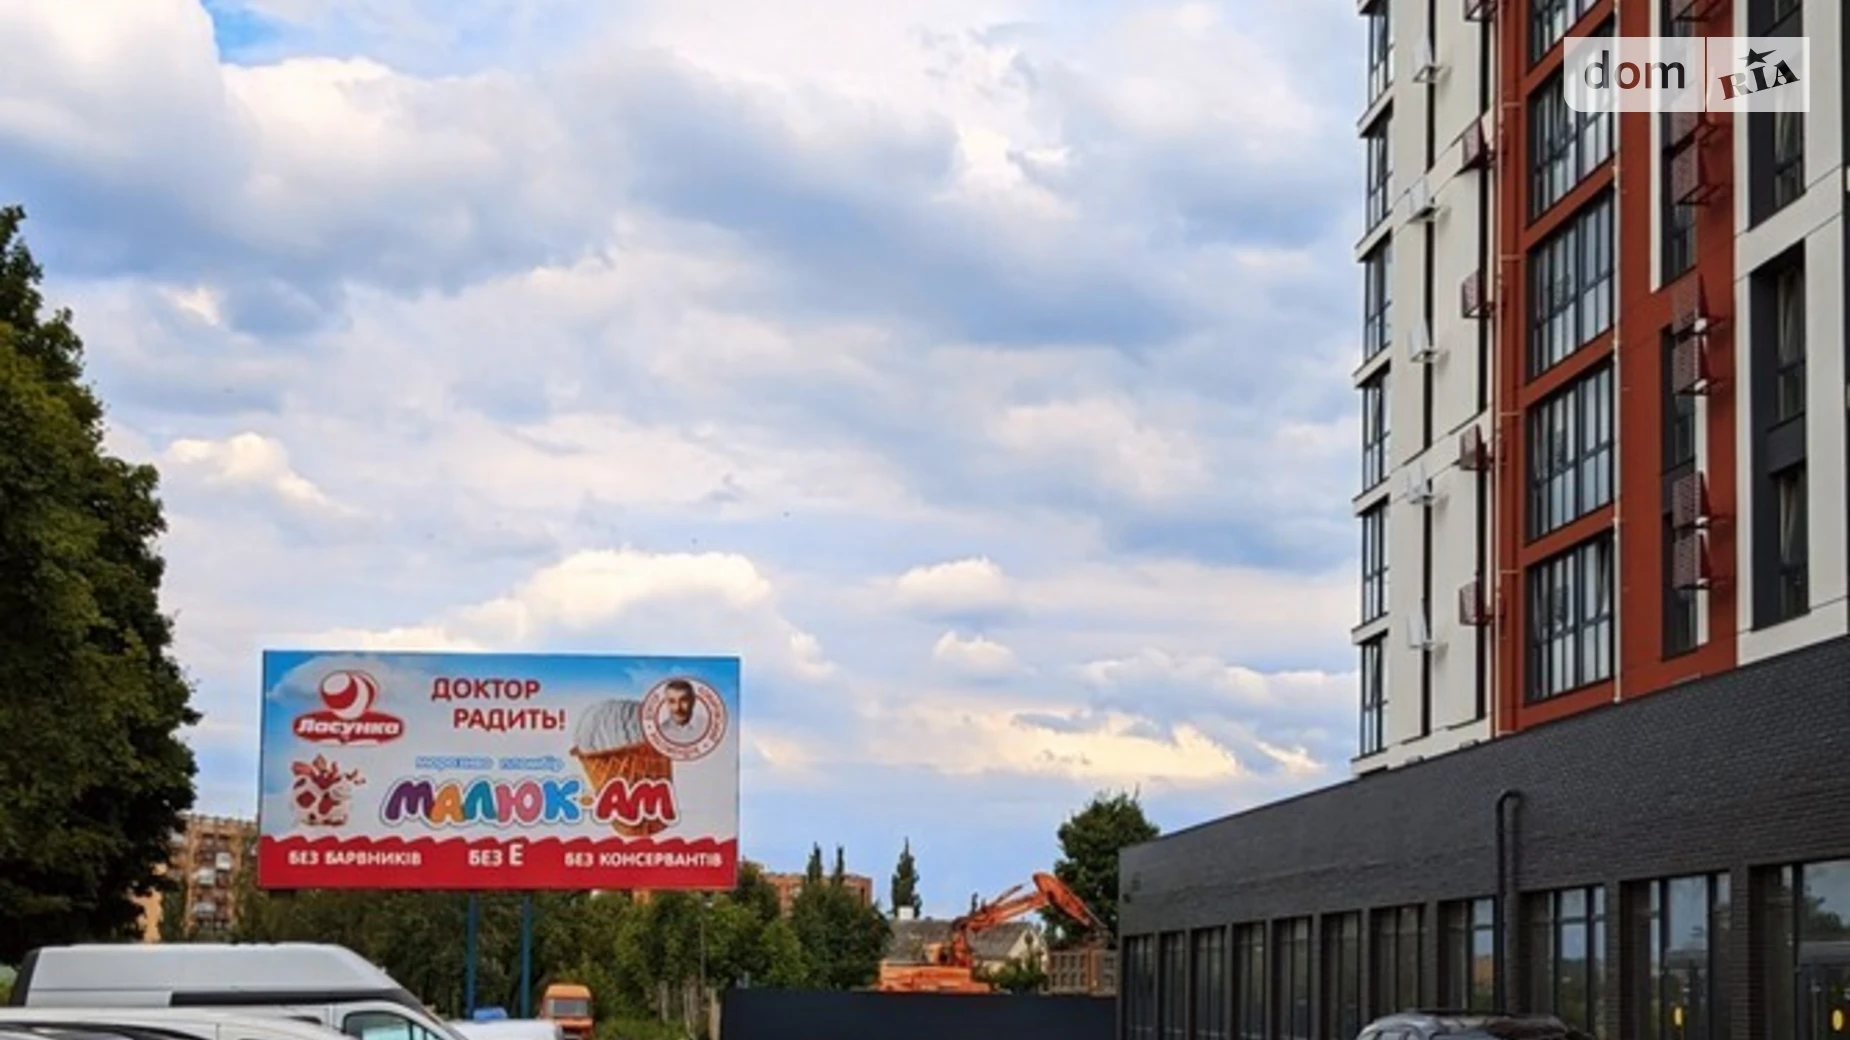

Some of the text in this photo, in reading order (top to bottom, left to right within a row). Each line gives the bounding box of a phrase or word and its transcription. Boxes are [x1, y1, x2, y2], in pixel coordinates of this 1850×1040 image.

[431, 677, 541, 702] ДОКТОР
[297, 717, 400, 743] Ласунка
[453, 707, 566, 732] РАДИТЬ!
[288, 850, 422, 866] БЕЗ БАРВНИКІВ
[467, 849, 503, 867] БЕЗ
[563, 851, 724, 868] БЕЗ КОНСЕРВАНТІВ
